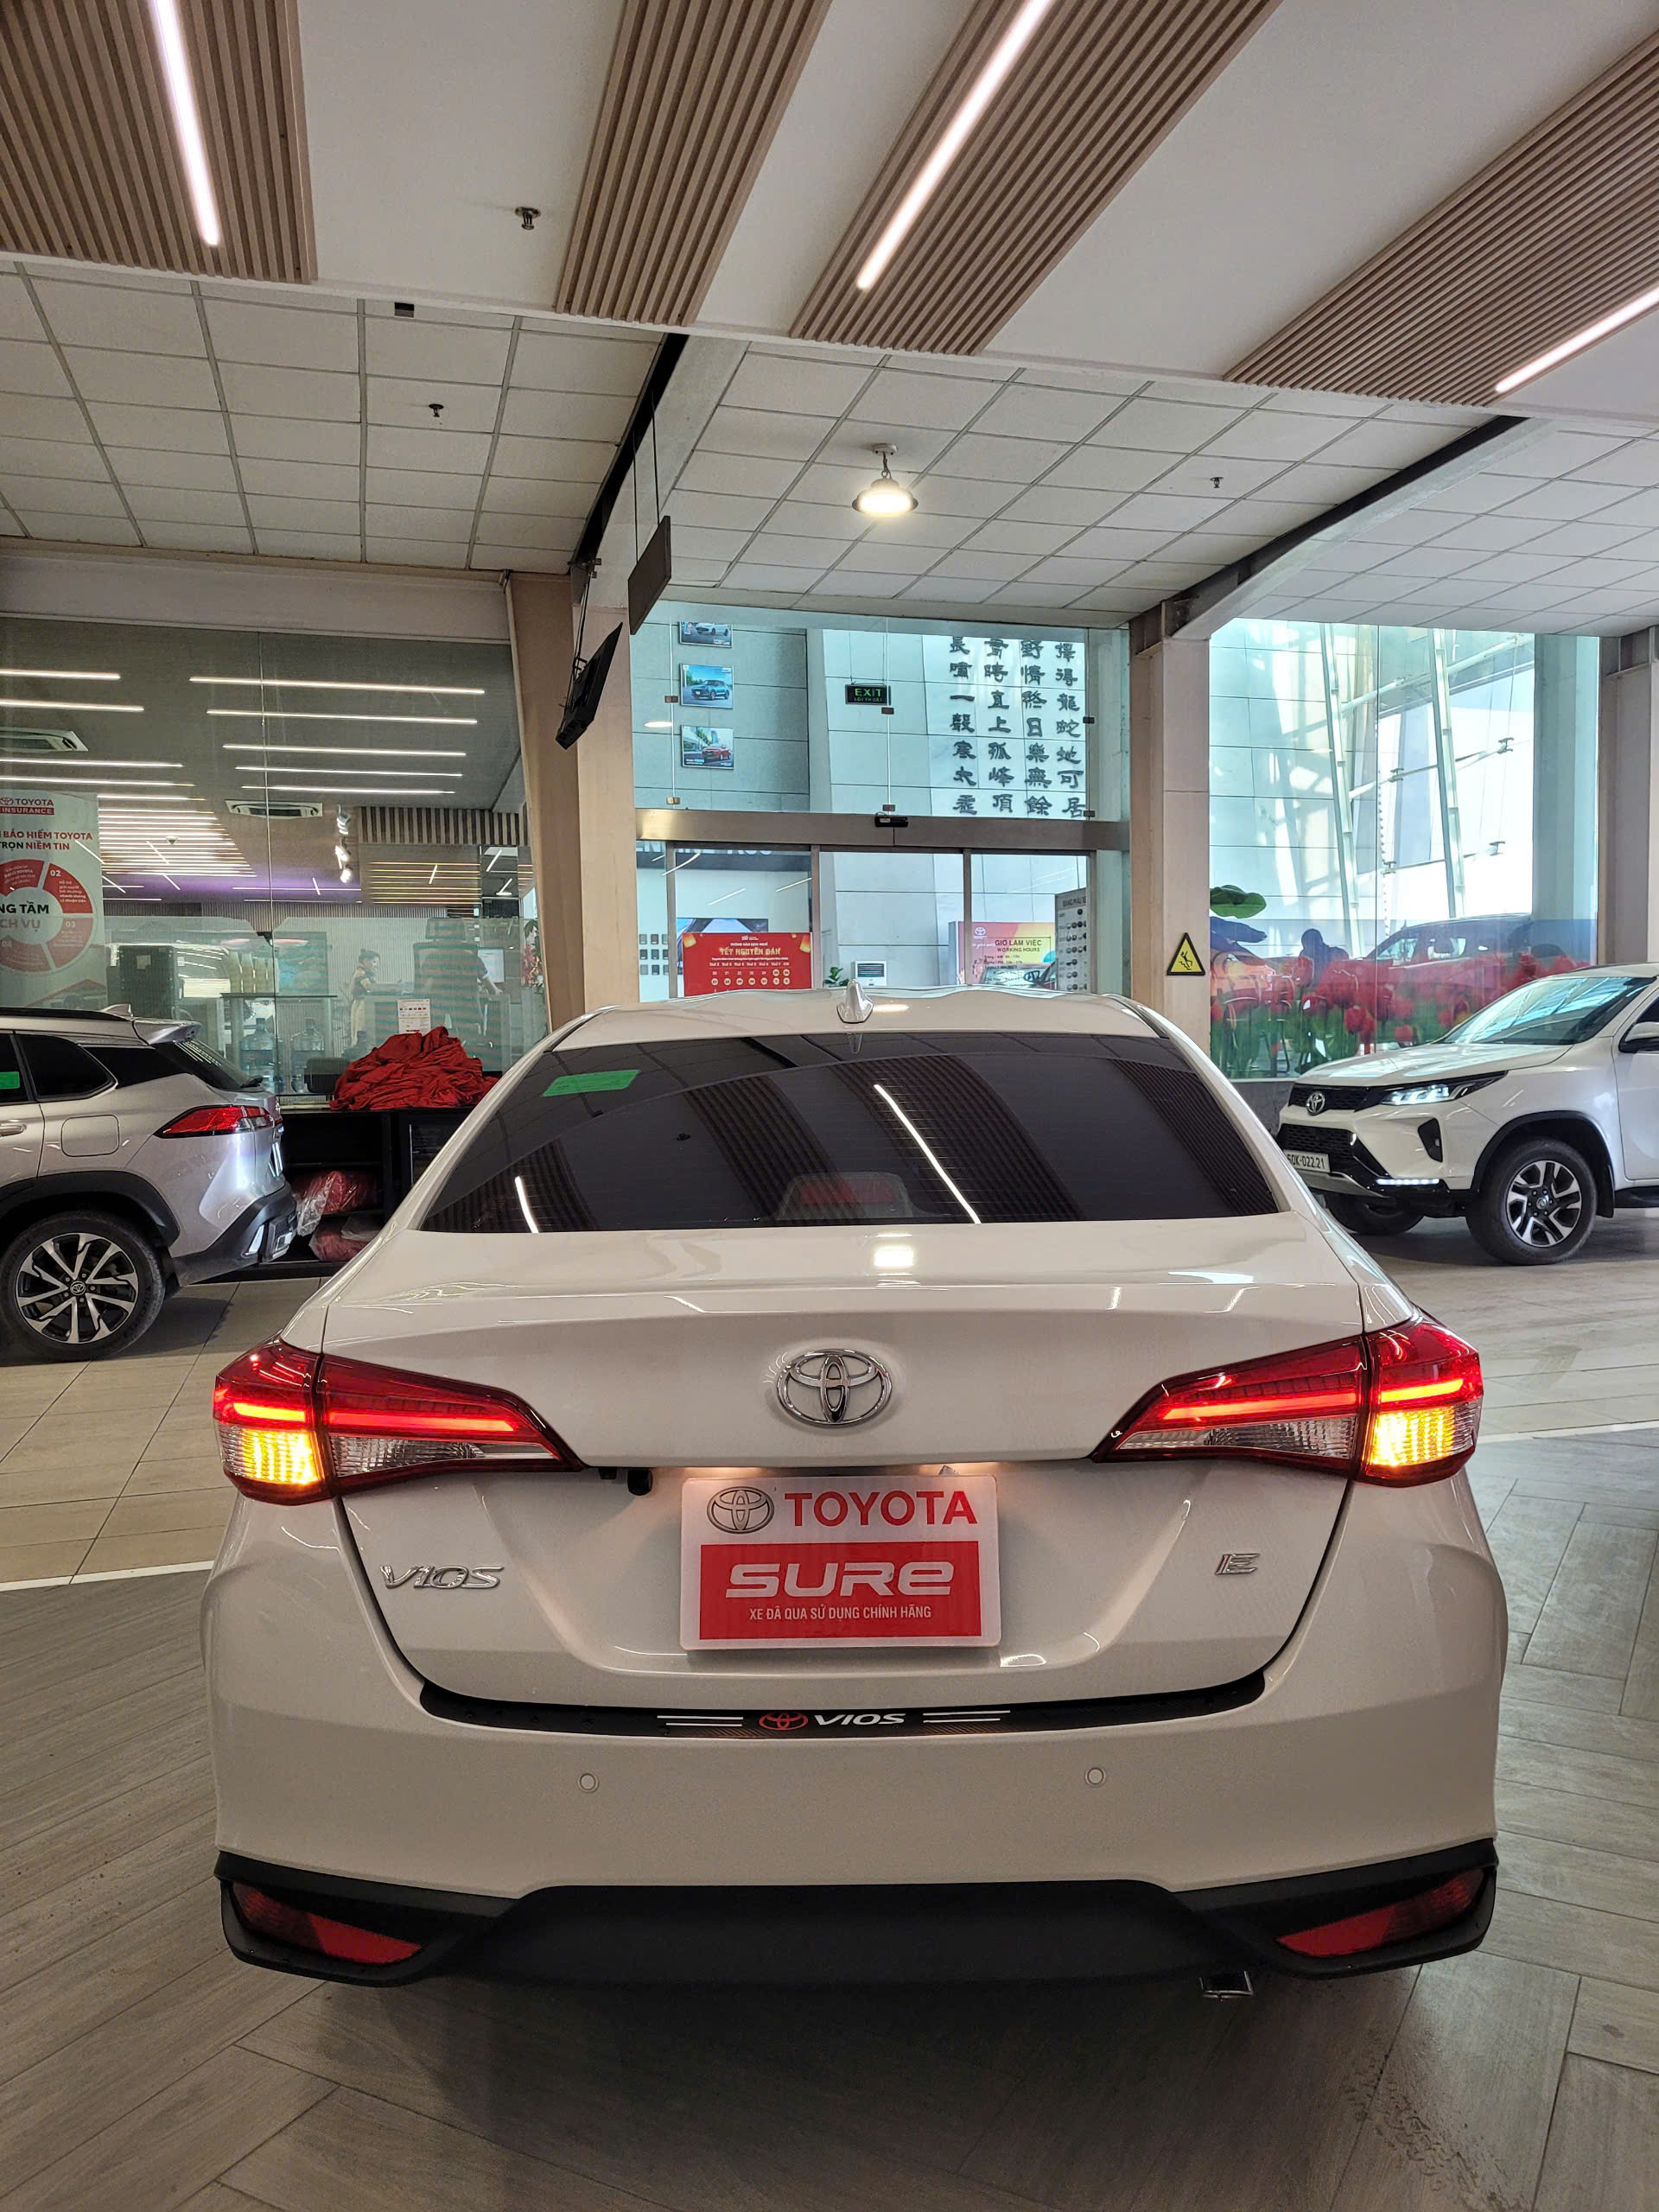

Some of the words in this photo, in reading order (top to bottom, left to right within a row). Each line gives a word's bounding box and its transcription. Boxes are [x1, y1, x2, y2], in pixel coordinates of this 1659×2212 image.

[855, 688, 882, 696] EXIT
[3, 828, 25, 838] BẢO
[719, 945, 733, 955] TẾT
[784, 1490, 978, 1527] TOYOTA
[1214, 1553, 1261, 1575] E
[378, 1565, 505, 1590] VIOS
[749, 1608, 763, 1620] XE
[766, 1605, 781, 1620] ĐÃ
[785, 1607, 808, 1620] QUA
[810, 1604, 827, 1620] SỬ
[829, 1607, 861, 1623] DỤNG
[863, 1604, 897, 1619] CHÍNH
[900, 1604, 931, 1618] HÃNG
[814, 1713, 906, 1726] VIOS
